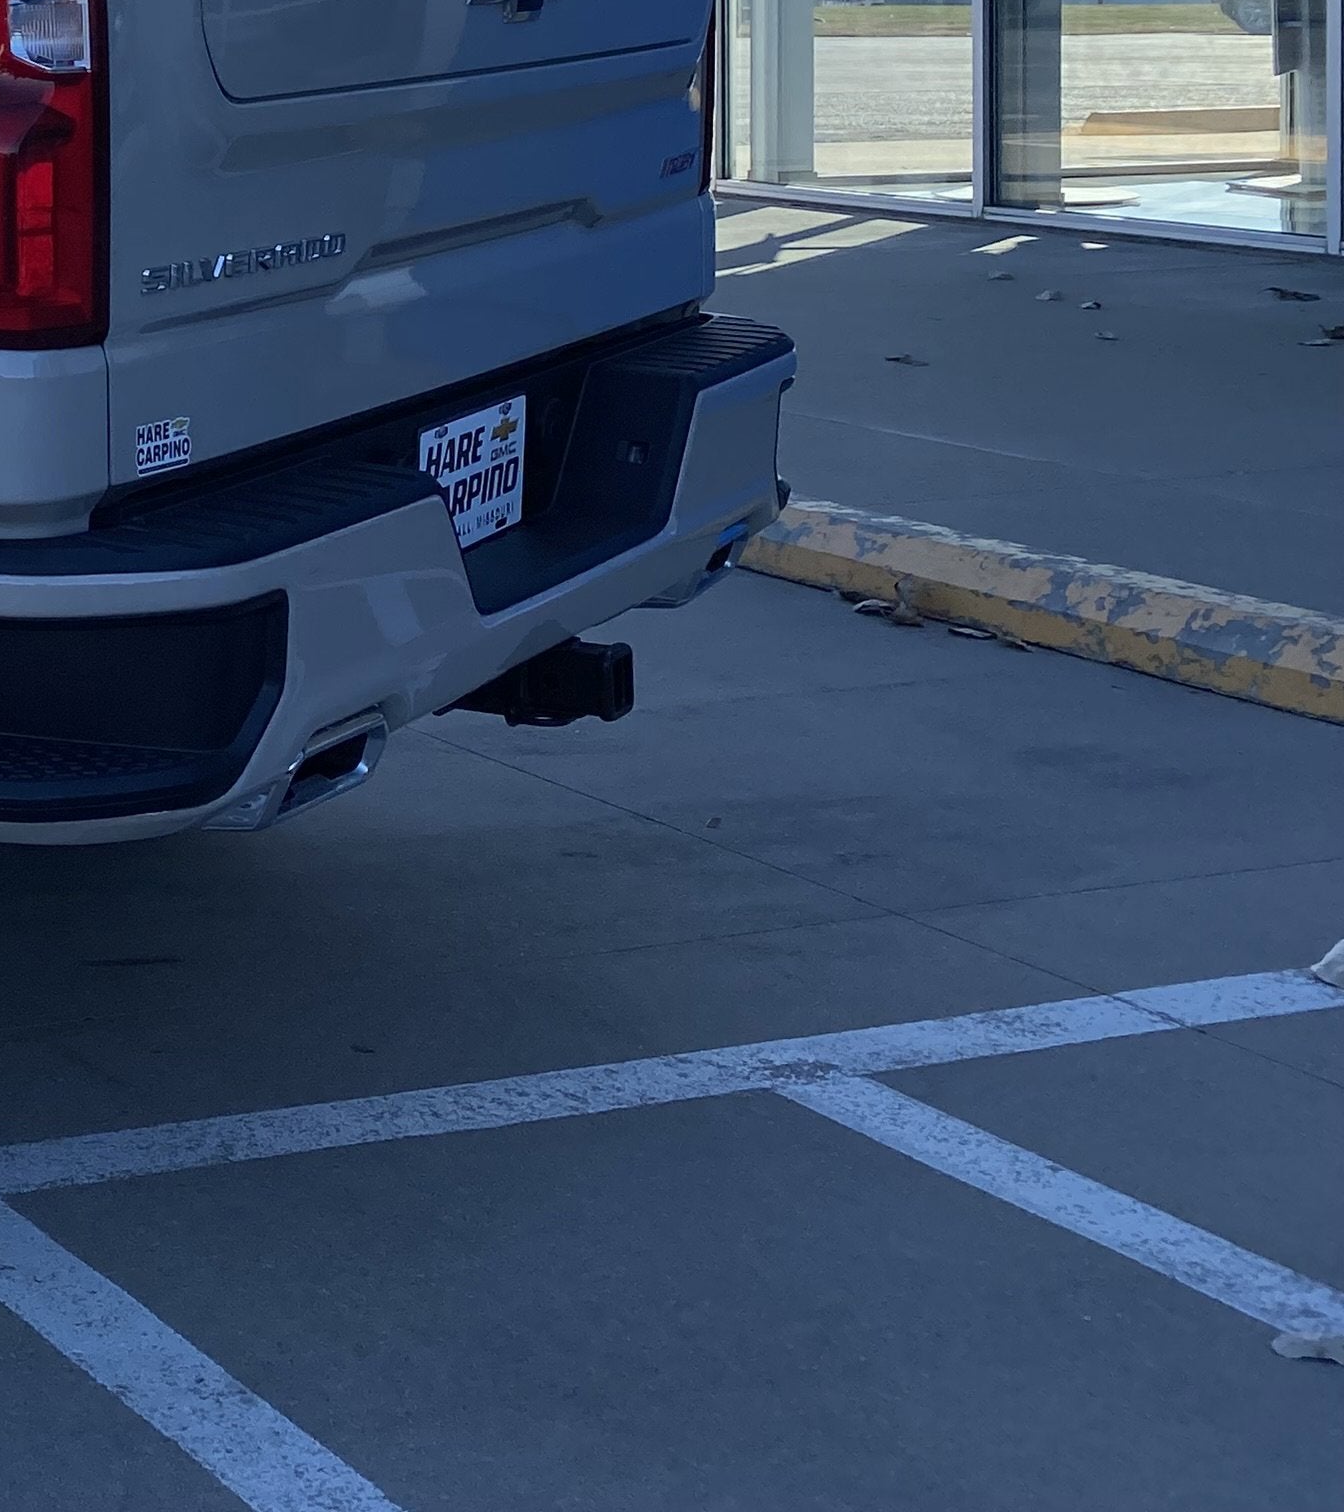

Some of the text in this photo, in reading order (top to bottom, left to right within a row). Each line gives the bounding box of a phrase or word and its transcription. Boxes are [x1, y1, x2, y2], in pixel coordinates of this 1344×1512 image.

[141, 234, 346, 292] SILVERADO
[137, 422, 170, 446] HARE
[137, 438, 190, 466] CARPINO
[427, 426, 485, 479] HARE
[491, 442, 517, 461] GMC
